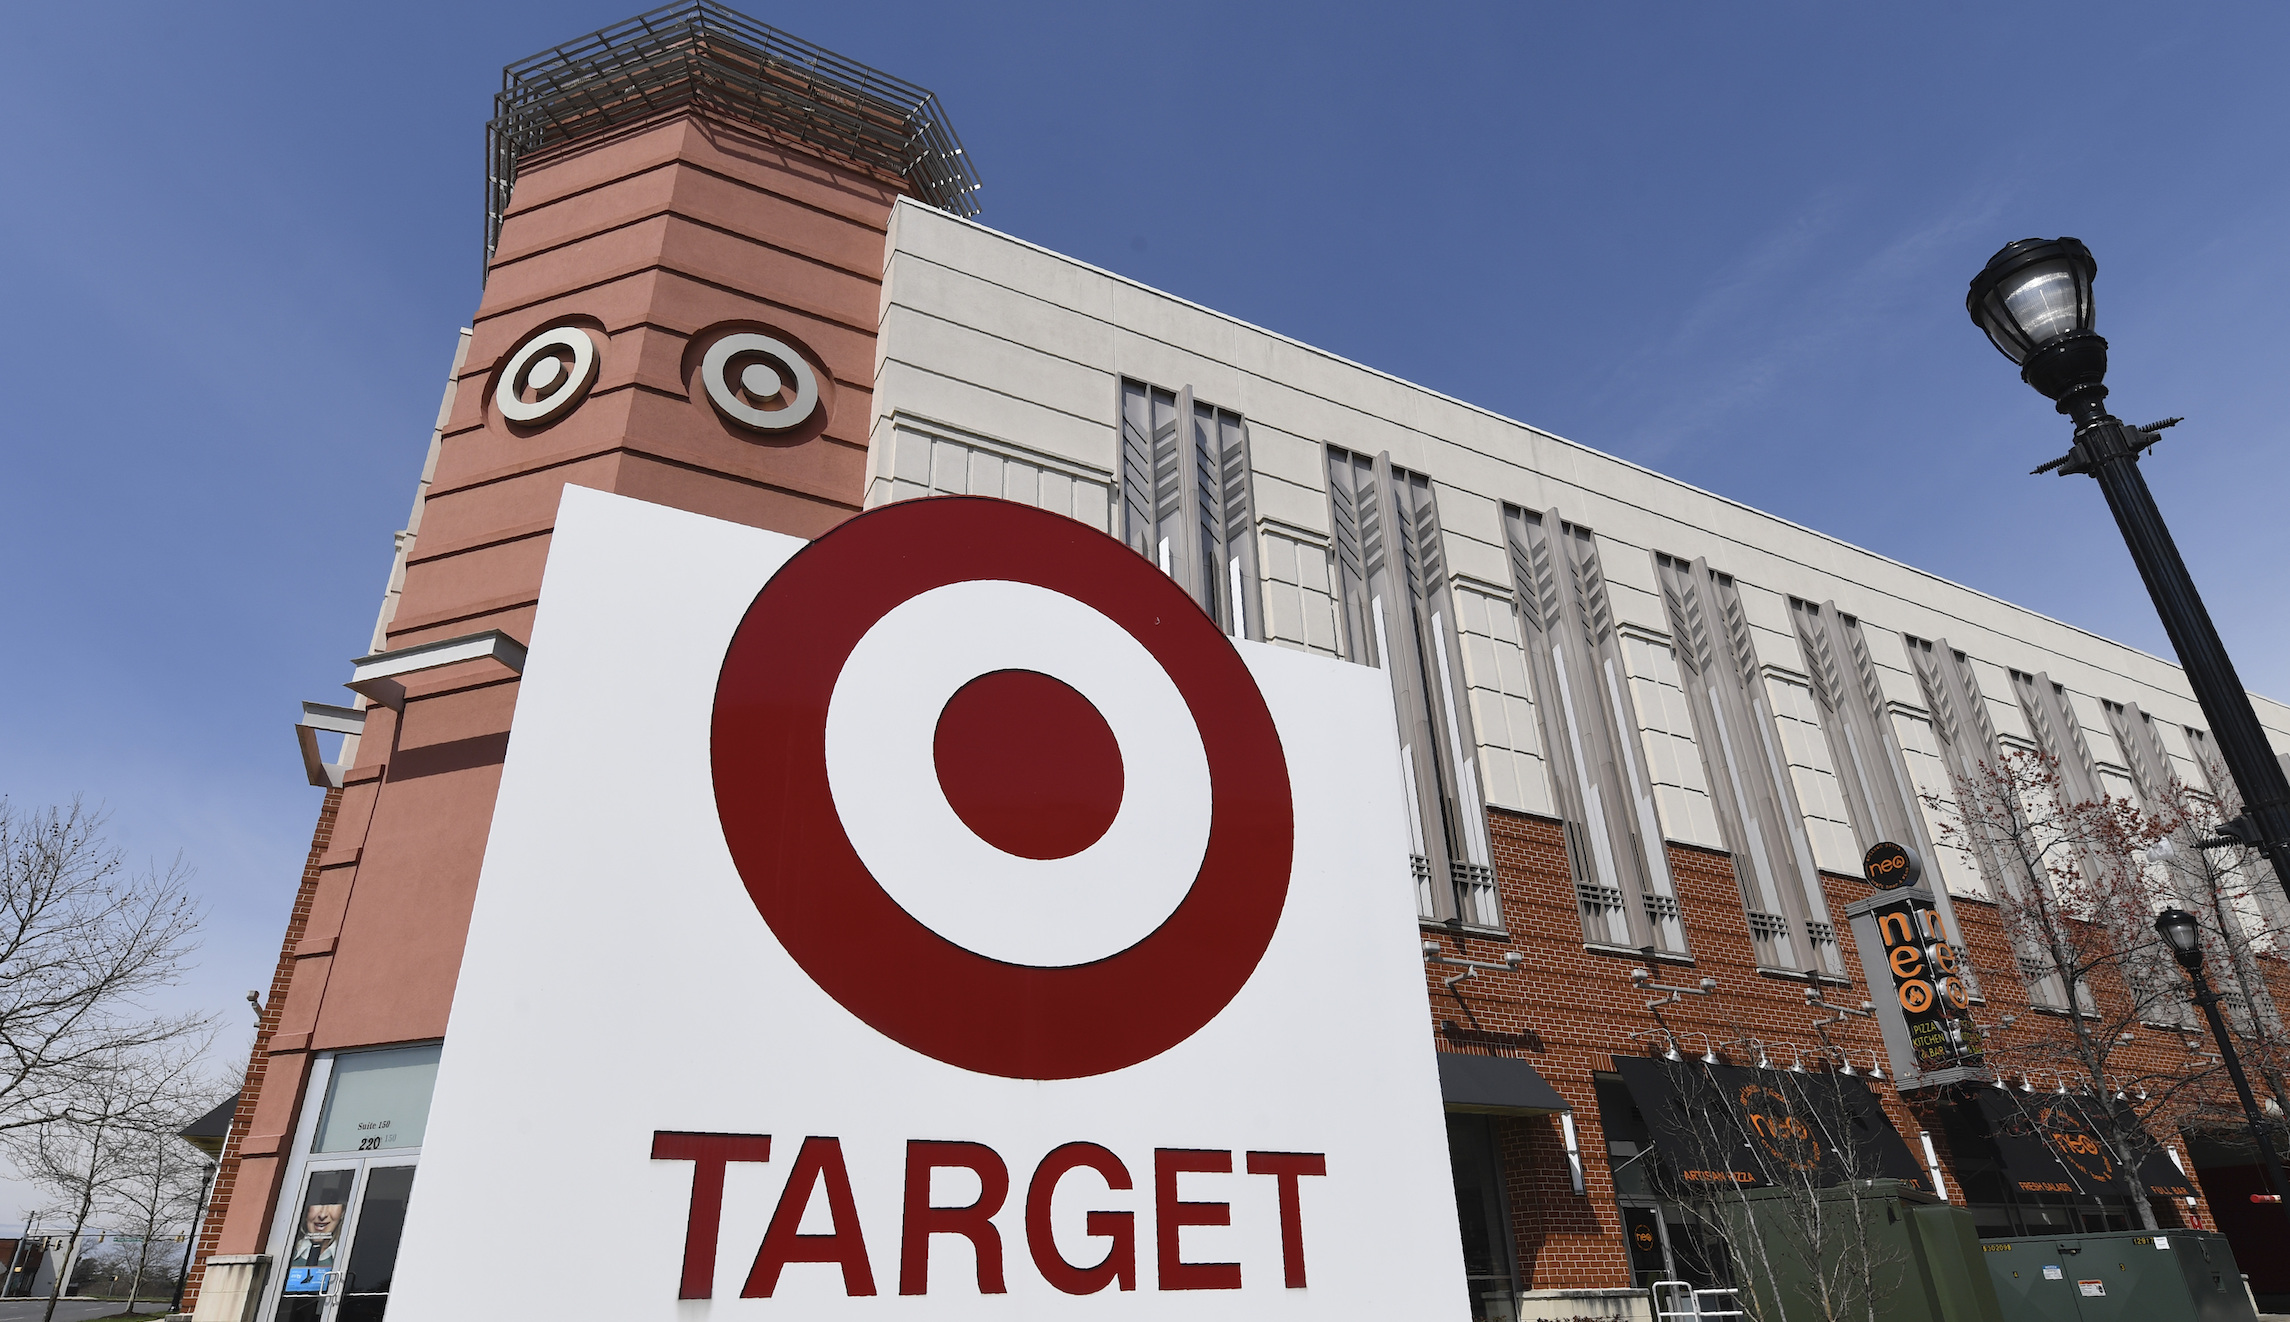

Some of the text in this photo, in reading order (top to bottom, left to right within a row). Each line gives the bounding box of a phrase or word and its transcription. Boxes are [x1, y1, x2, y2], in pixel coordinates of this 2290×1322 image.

[1869, 855, 1906, 878] neo
[1912, 1021, 1938, 1035] PIZZA
[1911, 1033, 1946, 1048] KITCHEN
[1928, 1045, 1946, 1059] BAR
[357, 1120, 391, 1131] Suite 150
[358, 1136, 381, 1151] 220
[2052, 1132, 2098, 1155] neo
[2150, 1185, 2173, 1195] FULL
[650, 1130, 1327, 1301] TARGET
